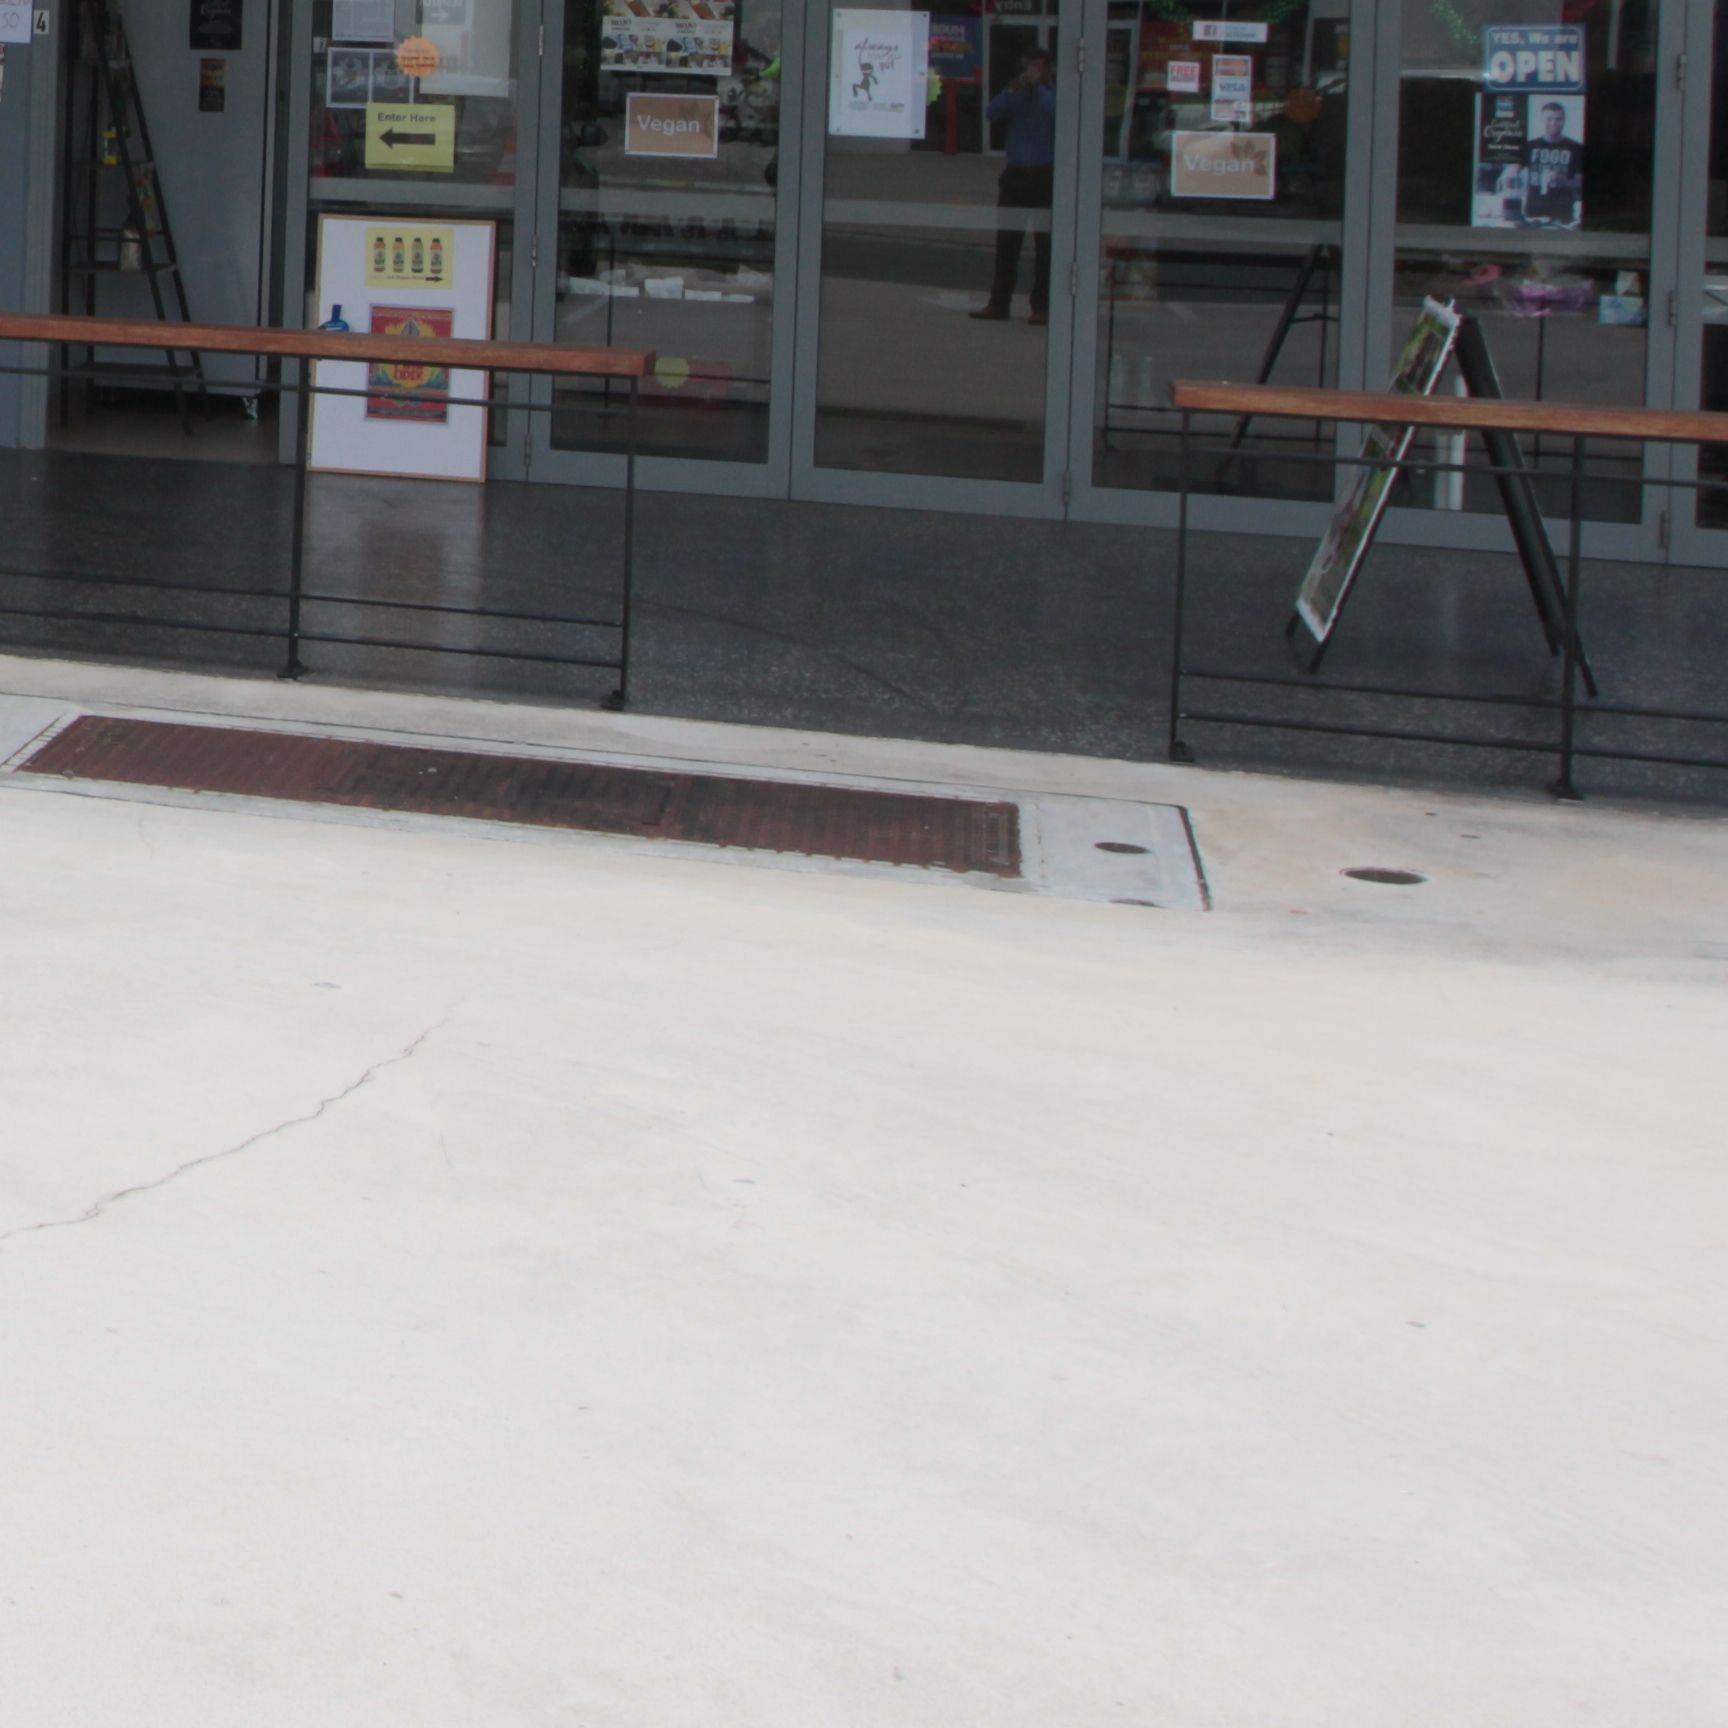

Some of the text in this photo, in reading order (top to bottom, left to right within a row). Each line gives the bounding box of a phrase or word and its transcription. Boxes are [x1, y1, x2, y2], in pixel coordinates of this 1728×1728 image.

[37, 12, 45, 32] 4
[1491, 32, 1577, 46] YES, We are
[1490, 50, 1579, 83] OPEN
[377, 112, 436, 123] Enter Here
[636, 114, 700, 136] Vegan
[1184, 154, 1253, 176] Vegan
[1531, 148, 1571, 165] FOOD
